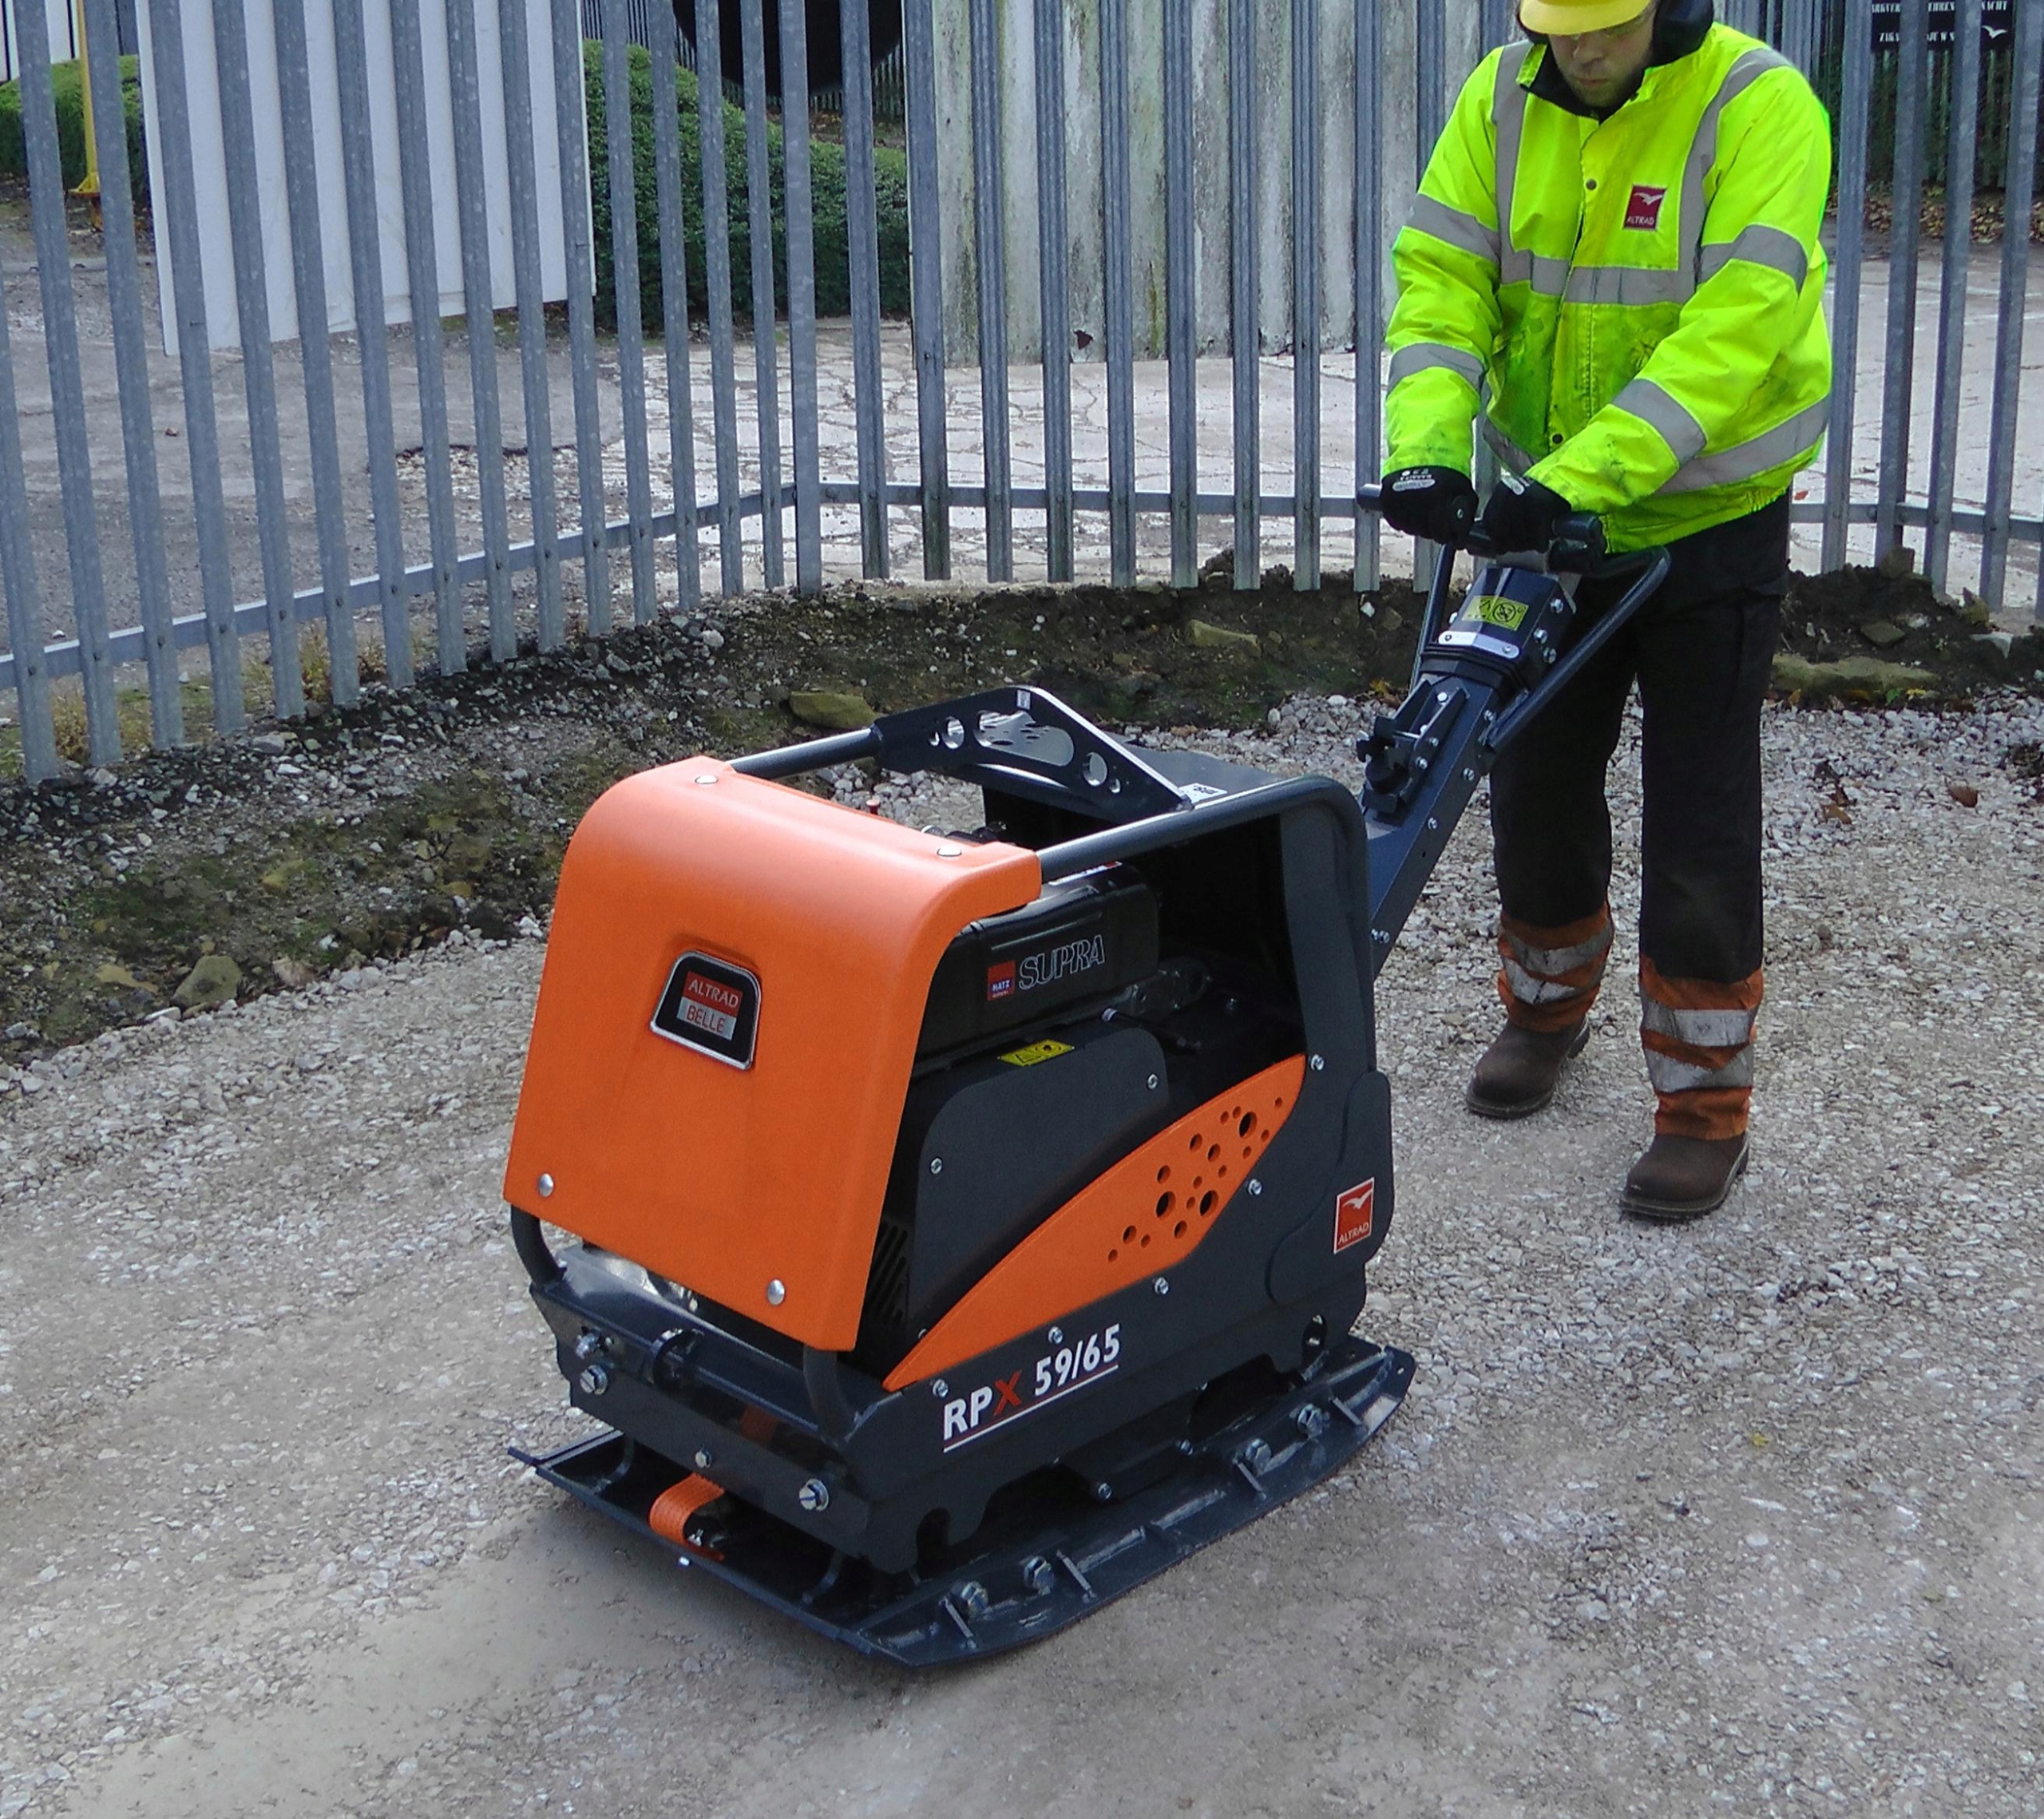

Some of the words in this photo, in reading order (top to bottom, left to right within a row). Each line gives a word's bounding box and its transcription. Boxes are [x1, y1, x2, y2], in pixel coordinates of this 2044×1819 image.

[1626, 216, 1655, 225] ALTRAD
[1019, 934, 1106, 990] SUPRA
[689, 979, 739, 1008] ALTRAD
[687, 1005, 726, 1033] BELLE
[1338, 1223, 1369, 1246] ALTRAD
[944, 1369, 1022, 1441] RPX
[1035, 1324, 1119, 1396] 59/65
